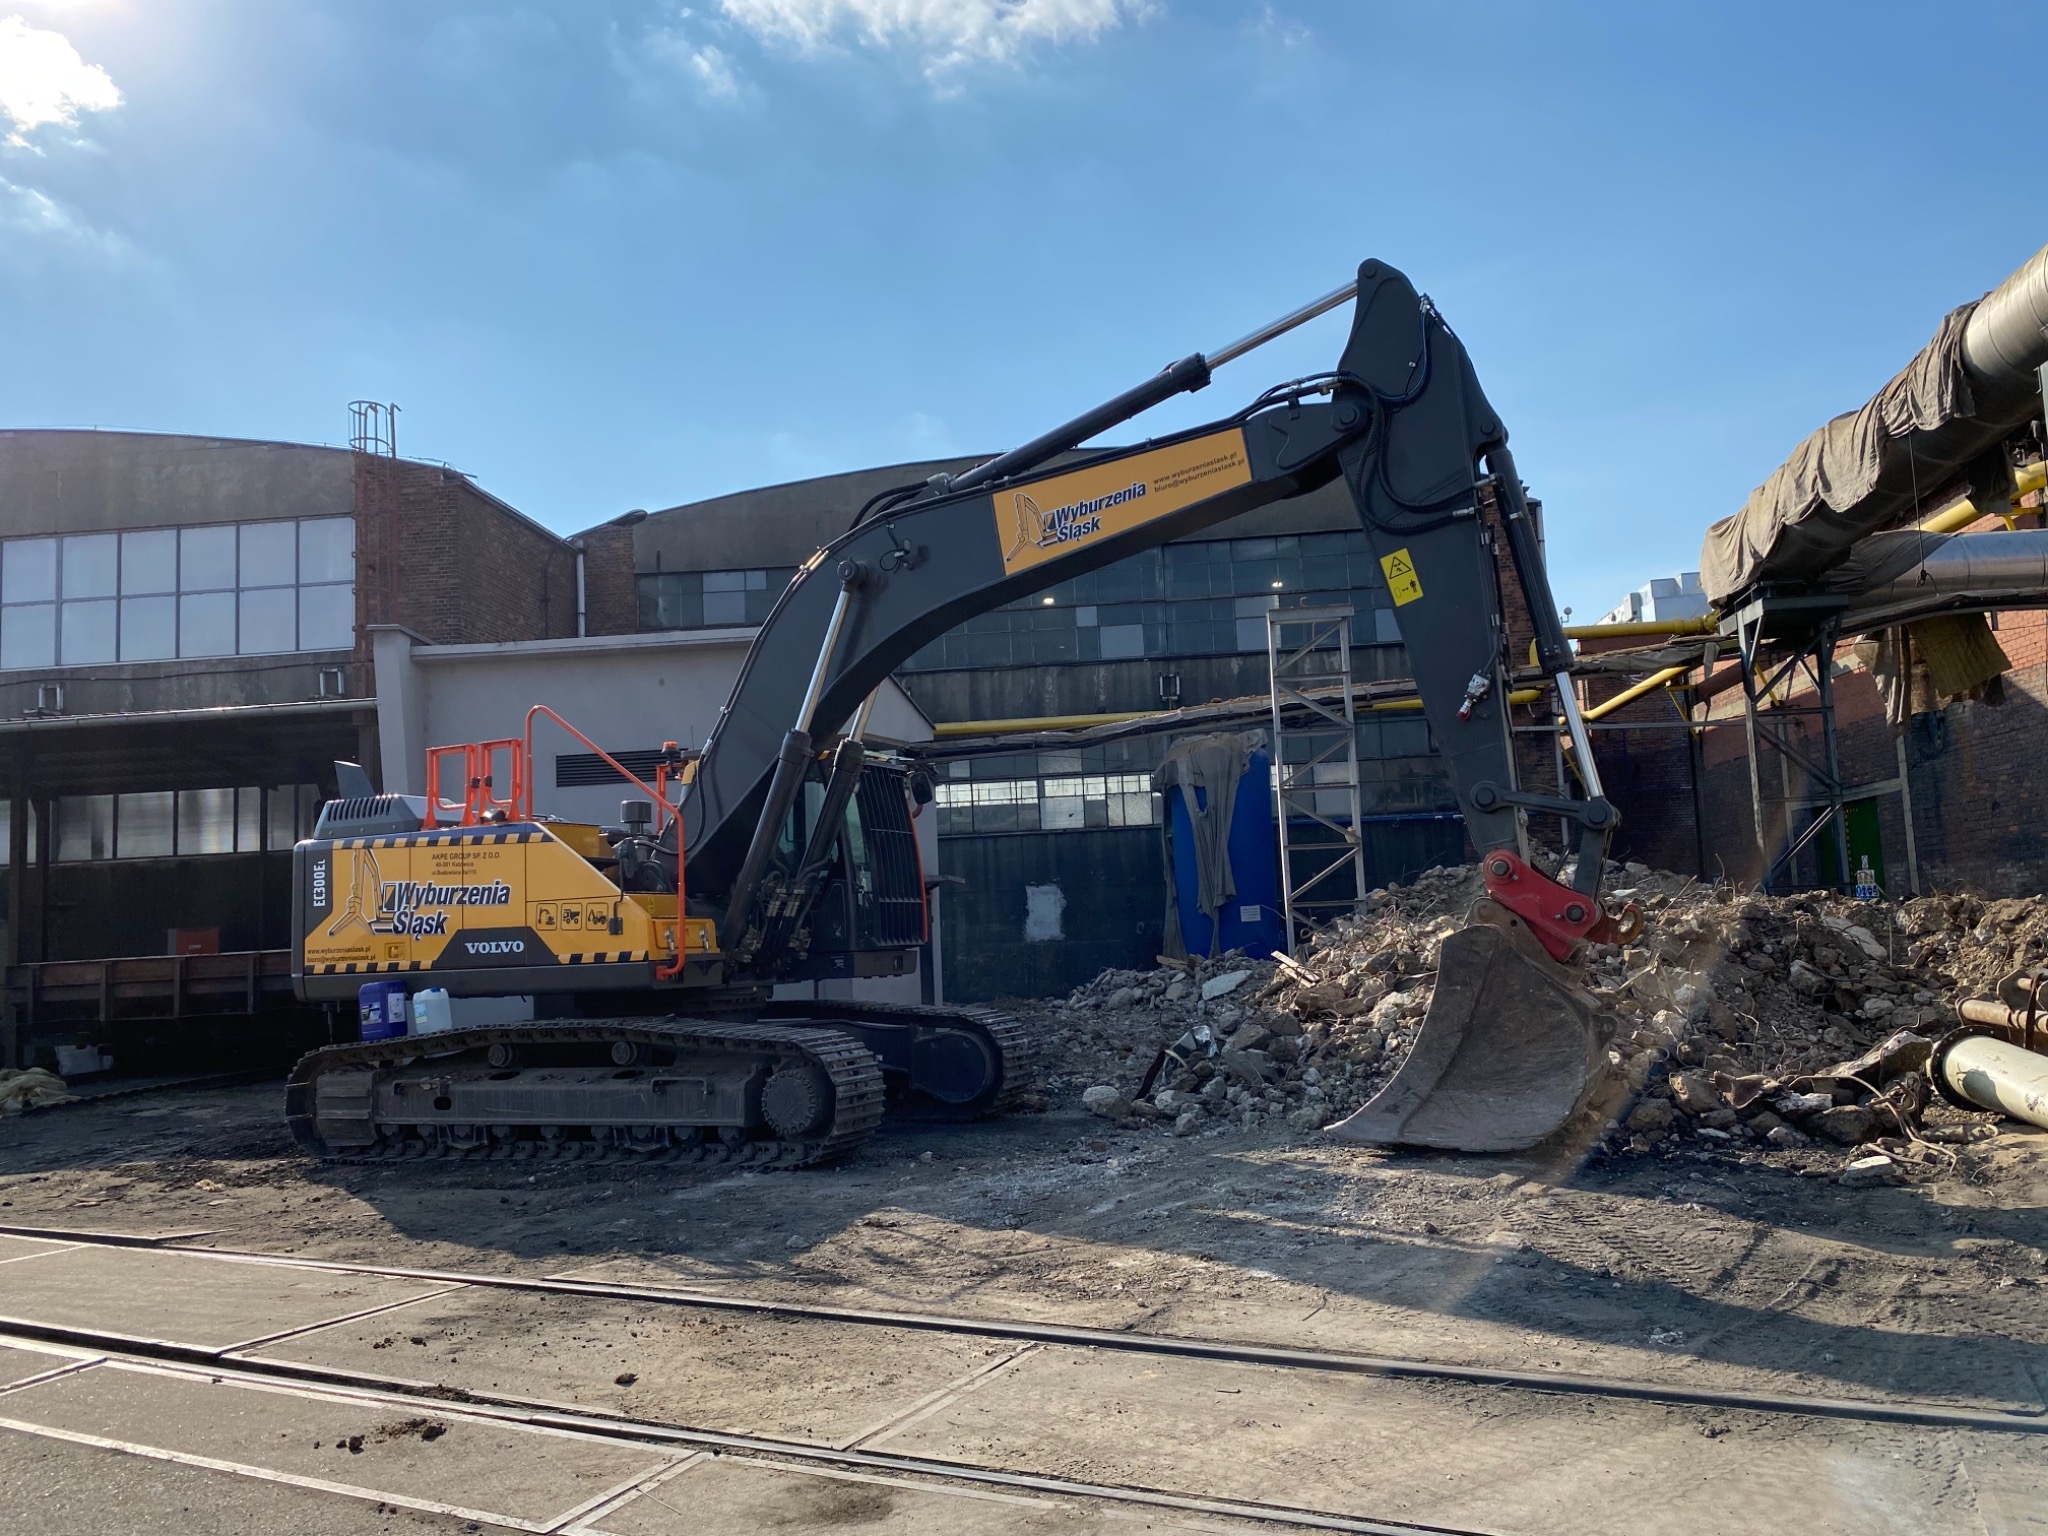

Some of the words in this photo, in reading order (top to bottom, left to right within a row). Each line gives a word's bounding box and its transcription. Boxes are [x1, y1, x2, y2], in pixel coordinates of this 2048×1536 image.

[1153, 451, 1237, 484] www.wyburzeniaslask.pl
[1056, 483, 1146, 528] Wyburzenia
[1057, 516, 1101, 543] Śląsk
[449, 852, 471, 860] GROUP
[482, 851, 487, 859] Z
[397, 880, 511, 911] Wyburzenia
[392, 905, 449, 941] Śląsk
[465, 940, 525, 954] VOLVO
